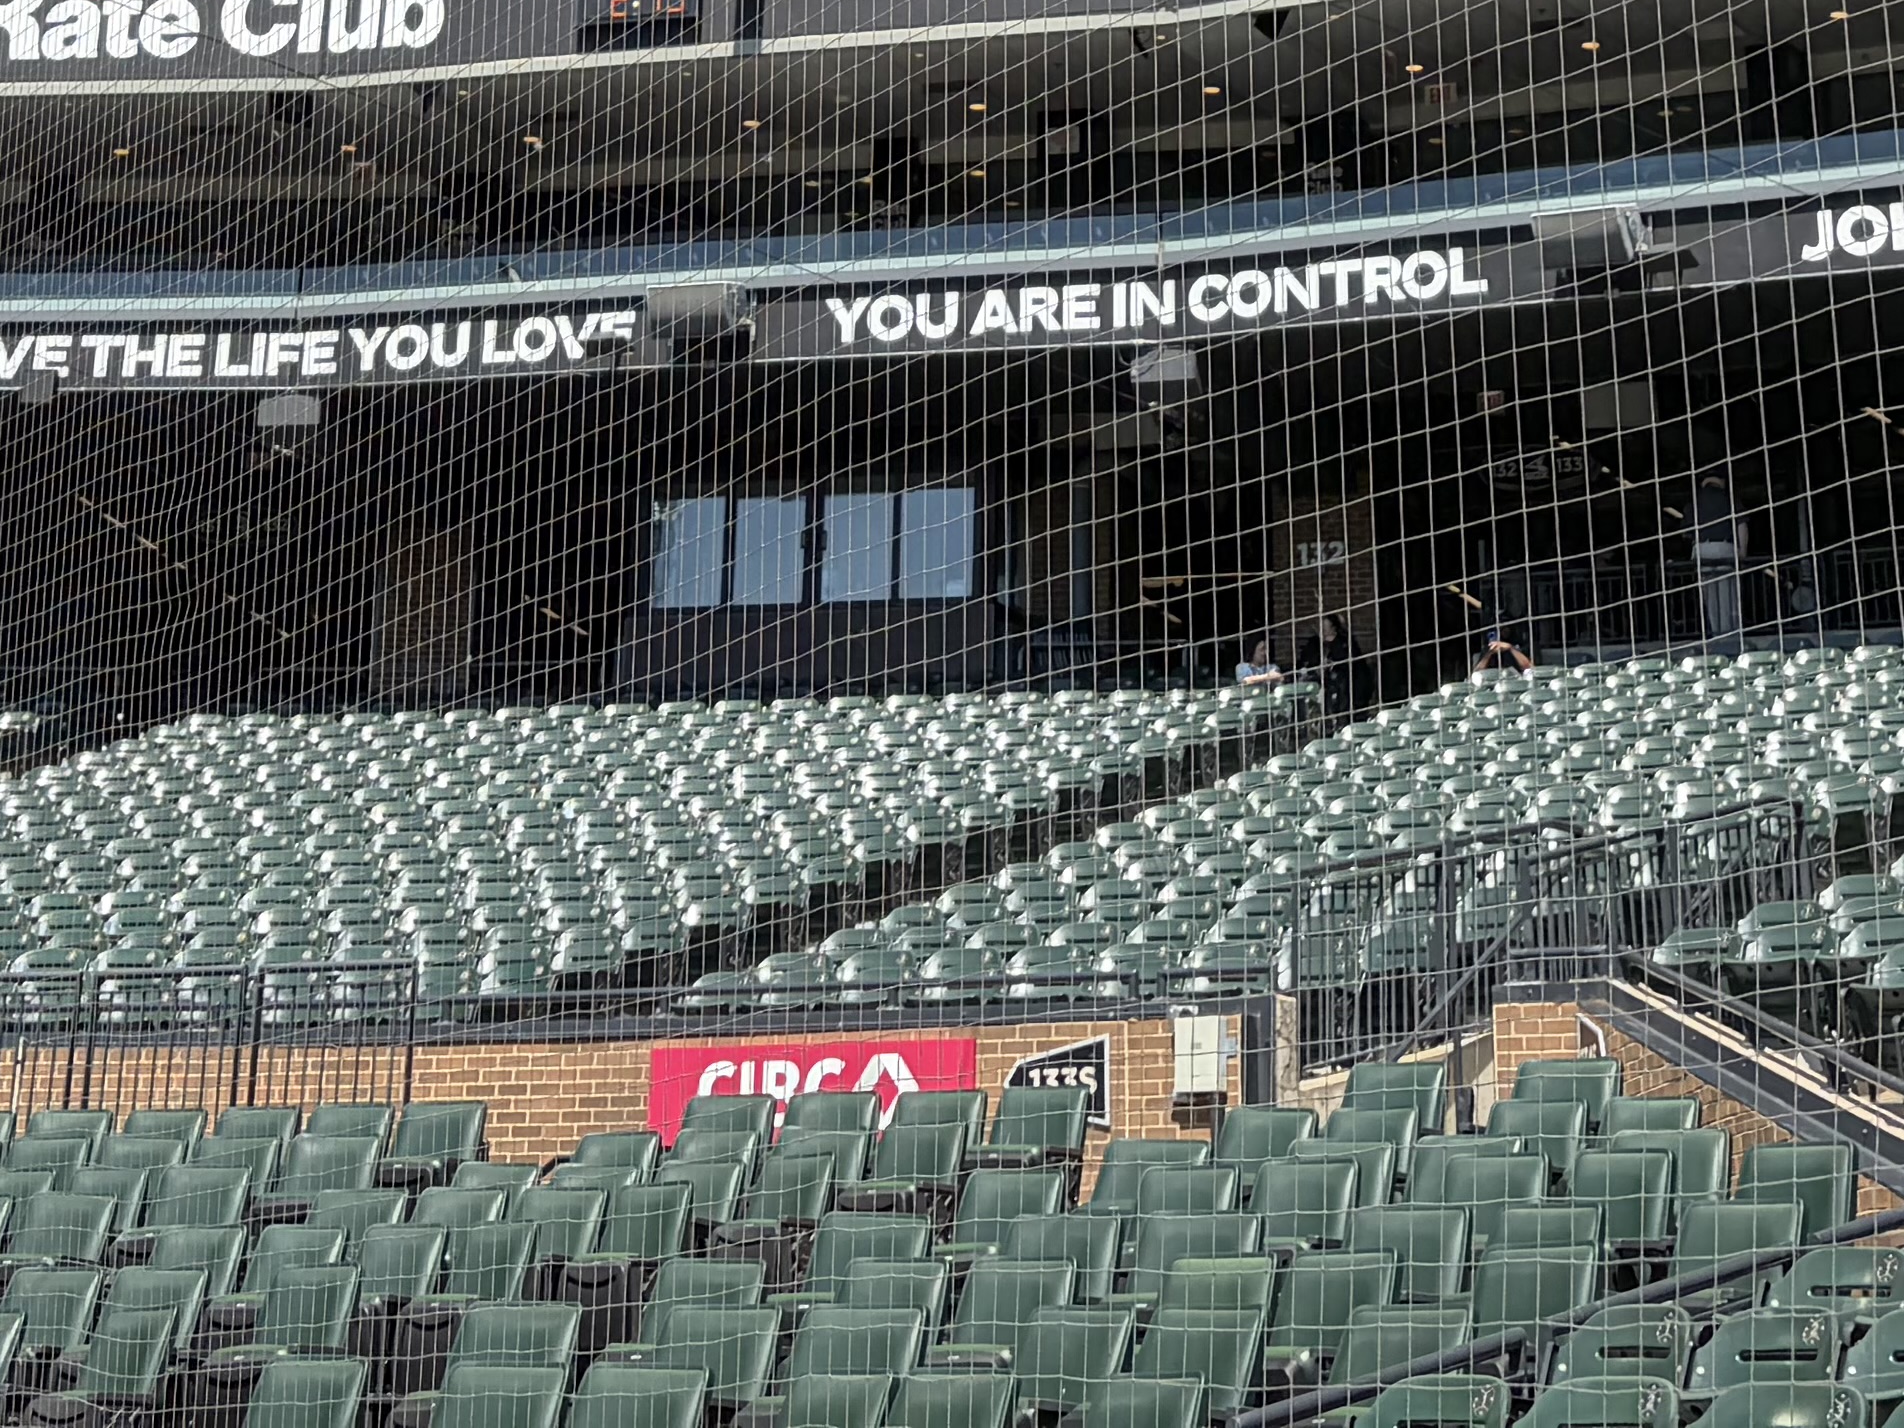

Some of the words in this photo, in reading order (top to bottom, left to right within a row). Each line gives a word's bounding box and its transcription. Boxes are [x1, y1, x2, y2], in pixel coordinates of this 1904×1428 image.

[824, 291, 959, 344] YOU
[969, 282, 1101, 334] ARE
[1112, 278, 1176, 328] IN
[1187, 246, 1489, 323] CONTROL
[82, 333, 205, 379] THE
[215, 328, 338, 378] LIFE
[348, 320, 471, 372] YOU
